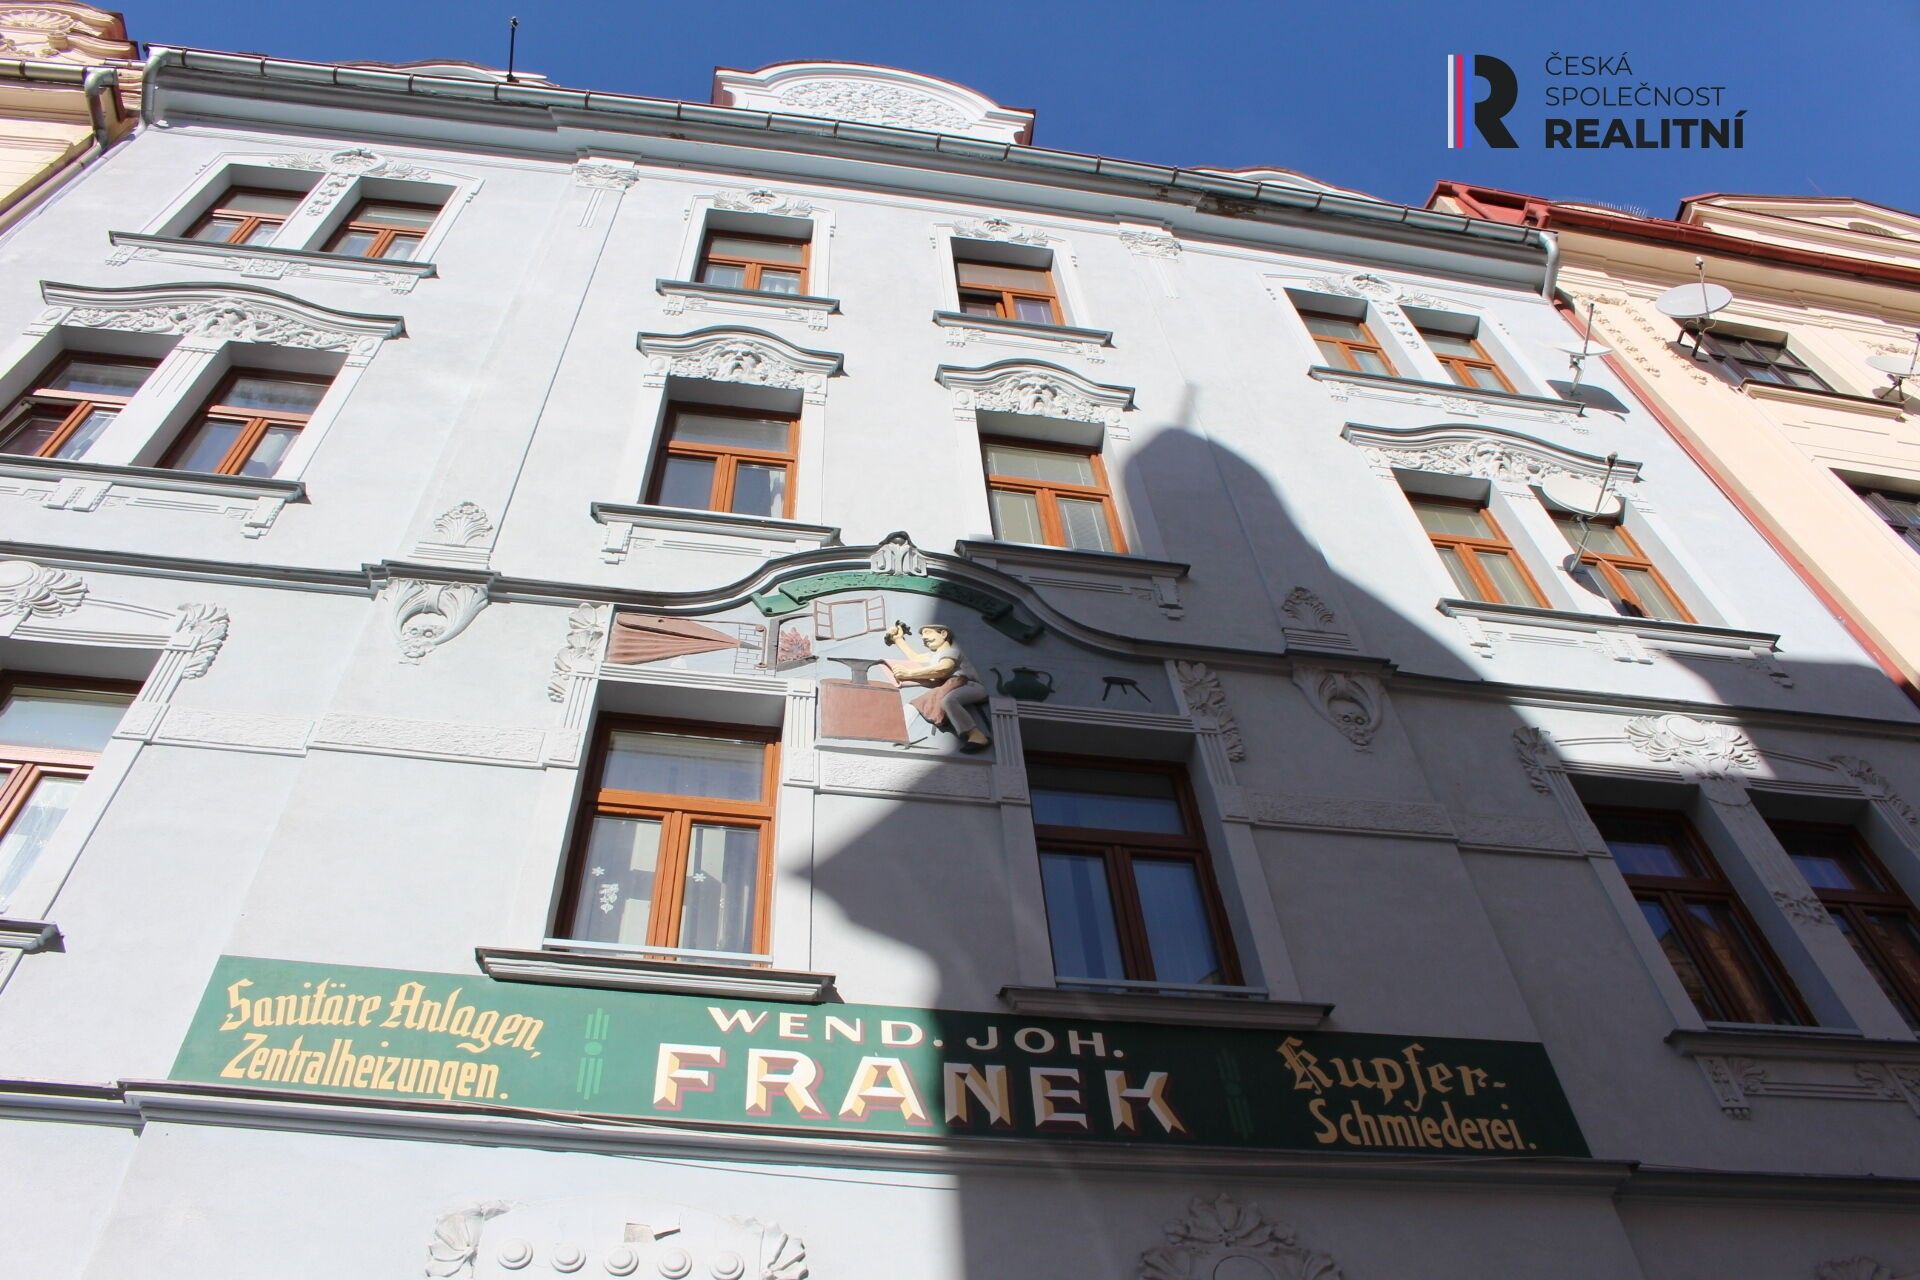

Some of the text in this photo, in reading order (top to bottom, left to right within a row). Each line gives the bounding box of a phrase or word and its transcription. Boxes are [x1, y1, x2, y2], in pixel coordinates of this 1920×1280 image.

[219, 977, 544, 1059] Sanitäre Anlagen,
[707, 1006, 1125, 1058] WEND. JOH.
[220, 1033, 509, 1101] Zentralheizungen.
[653, 1042, 1188, 1135] FRANEK
[1277, 1036, 1506, 1112] Kupfer-
[1308, 1098, 1537, 1151] Schmiederei.
